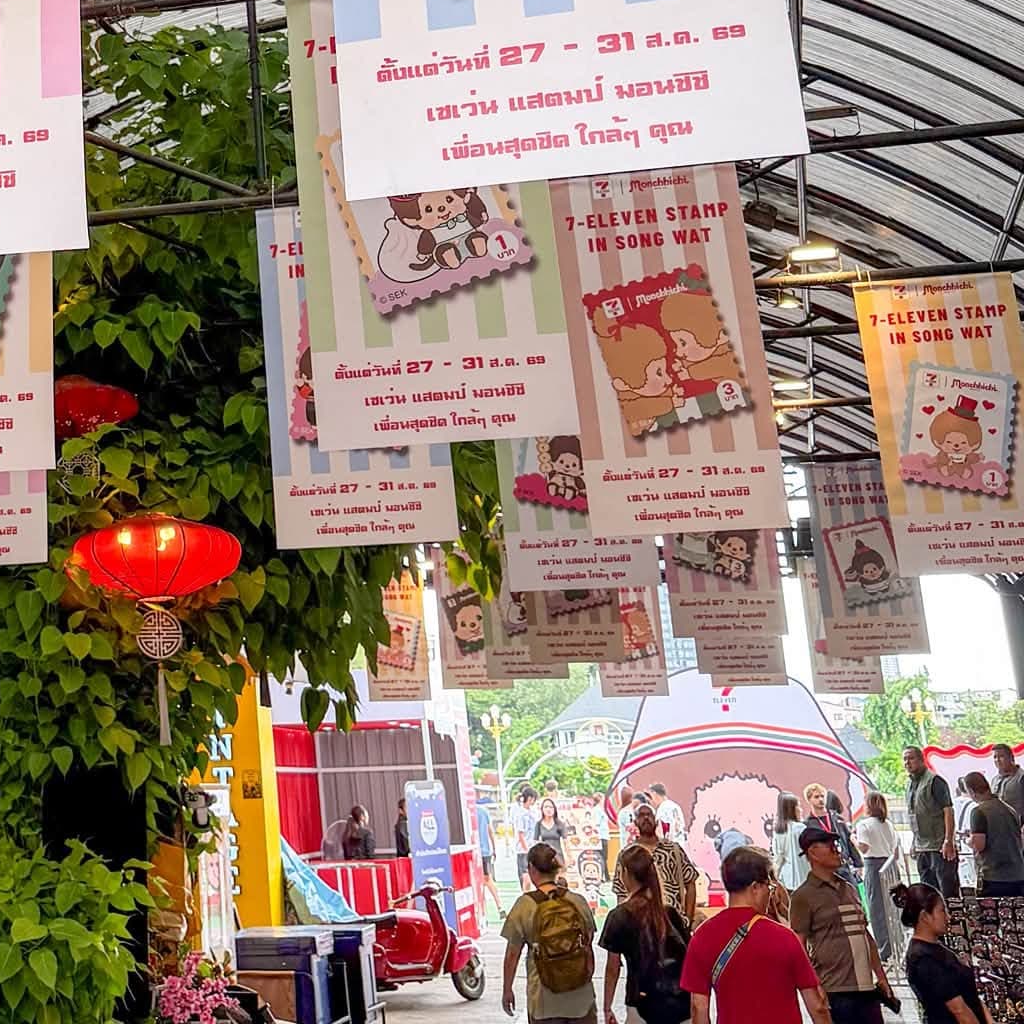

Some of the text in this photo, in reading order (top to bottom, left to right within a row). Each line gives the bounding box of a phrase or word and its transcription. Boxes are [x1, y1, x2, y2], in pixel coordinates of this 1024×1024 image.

[377, 45, 489, 82] ตั้งแต่วันที่
[499, 43, 545, 66] 27
[597, 32, 634, 53] 31
[712, 25, 745, 40] 69
[427, 70, 709, 121] เซเว่น แสตมป์ มอนชิชิ
[22, 129, 49, 143] 69
[650, 121, 693, 143] คุณ
[564, 202, 728, 232] 7-ELEVEN STAMP
[495, 235, 507, 250] 1
[587, 227, 711, 253] IN SONG WAT
[388, 289, 408, 301] SEK
[869, 304, 1006, 327] 7-ELEVEN STAMP
[889, 324, 993, 345] IN SONG WAT
[406, 360, 433, 374] 27
[461, 356, 484, 370] 31
[722, 382, 734, 395] 3
[657, 467, 679, 479] 27
[701, 465, 718, 476] 31
[339, 481, 394, 494] 27 31
[954, 522, 972, 531] 27
[990, 520, 1005, 529] 31
